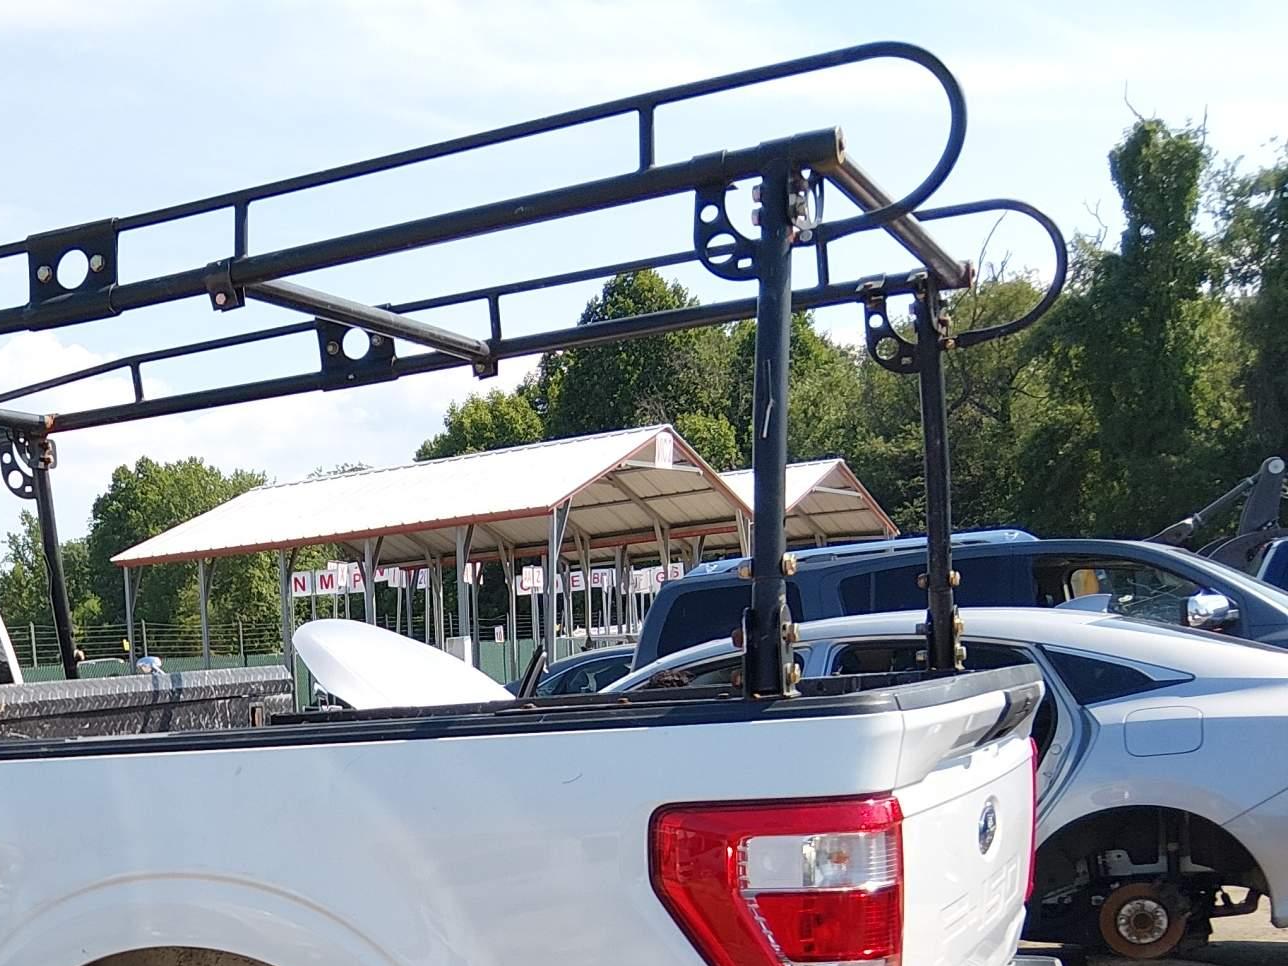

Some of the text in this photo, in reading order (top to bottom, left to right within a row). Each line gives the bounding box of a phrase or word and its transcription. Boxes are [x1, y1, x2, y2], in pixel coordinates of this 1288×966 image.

[294, 575, 306, 592] N
[319, 573, 334, 590] M
[571, 575, 580, 588] E
